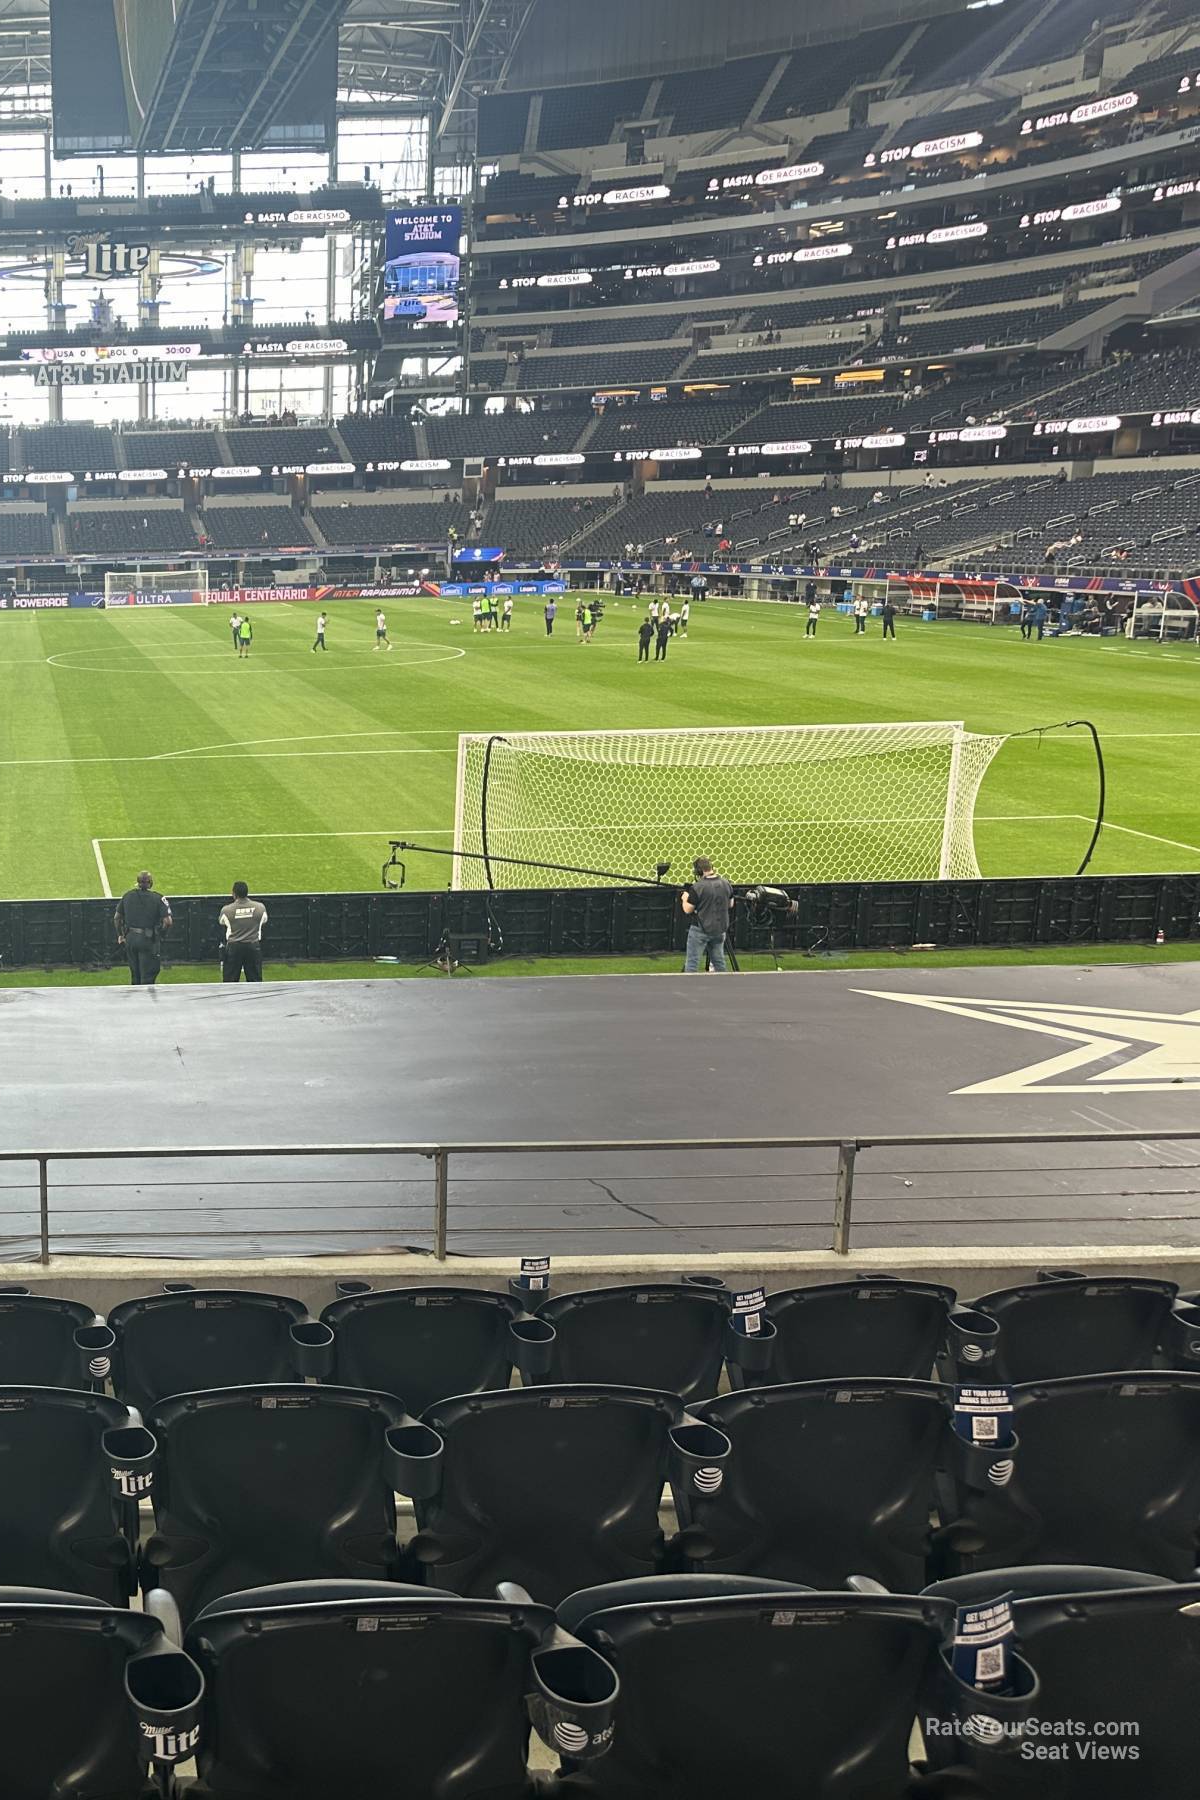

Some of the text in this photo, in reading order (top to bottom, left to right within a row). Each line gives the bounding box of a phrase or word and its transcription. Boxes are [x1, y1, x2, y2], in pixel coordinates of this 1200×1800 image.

[1036, 96, 1133, 129] BASTA DE RACISMO
[881, 136, 966, 163] STOP RACISM
[723, 166, 818, 188] BASTA DE RACISMO
[1166, 183, 1194, 197] BASTA
[574, 189, 654, 206] STOP RACISM
[258, 211, 345, 222] BASTA DE RACISMO
[1034, 201, 1108, 225] STOP RACISM
[395, 216, 438, 225] WELCOME
[413, 224, 434, 233] AT&T
[405, 231, 442, 240] STADIUM
[899, 226, 983, 246] BASTA DE RACISMO
[84, 243, 150, 280] Lite
[768, 248, 838, 264] STOP RACISM
[512, 276, 580, 287] STOP RACISM
[57, 350, 74, 358] USA
[110, 348, 127, 357] BOL
[133, 348, 138, 356] 0
[165, 346, 191, 354] 30:00
[257, 343, 283, 352] BASTA
[304, 341, 343, 350] RACISMO
[35, 361, 188, 386] AT&T STADIUM
[1045, 421, 1108, 433] STOP RACISM
[844, 437, 895, 448] STOP RACISM
[626, 450, 690, 460] STOP RACISM
[377, 461, 439, 471] STOP RACISM
[189, 469, 211, 477] STOP
[136, 594, 172, 604] ULTRA
[200, 588, 308, 603] TEQUILA CENTENARIO
[13, 598, 68, 609] POWERADE
[120, 1472, 152, 1496] Lite
[139, 1721, 174, 1736] Miller
[148, 1724, 199, 1761] Lite
